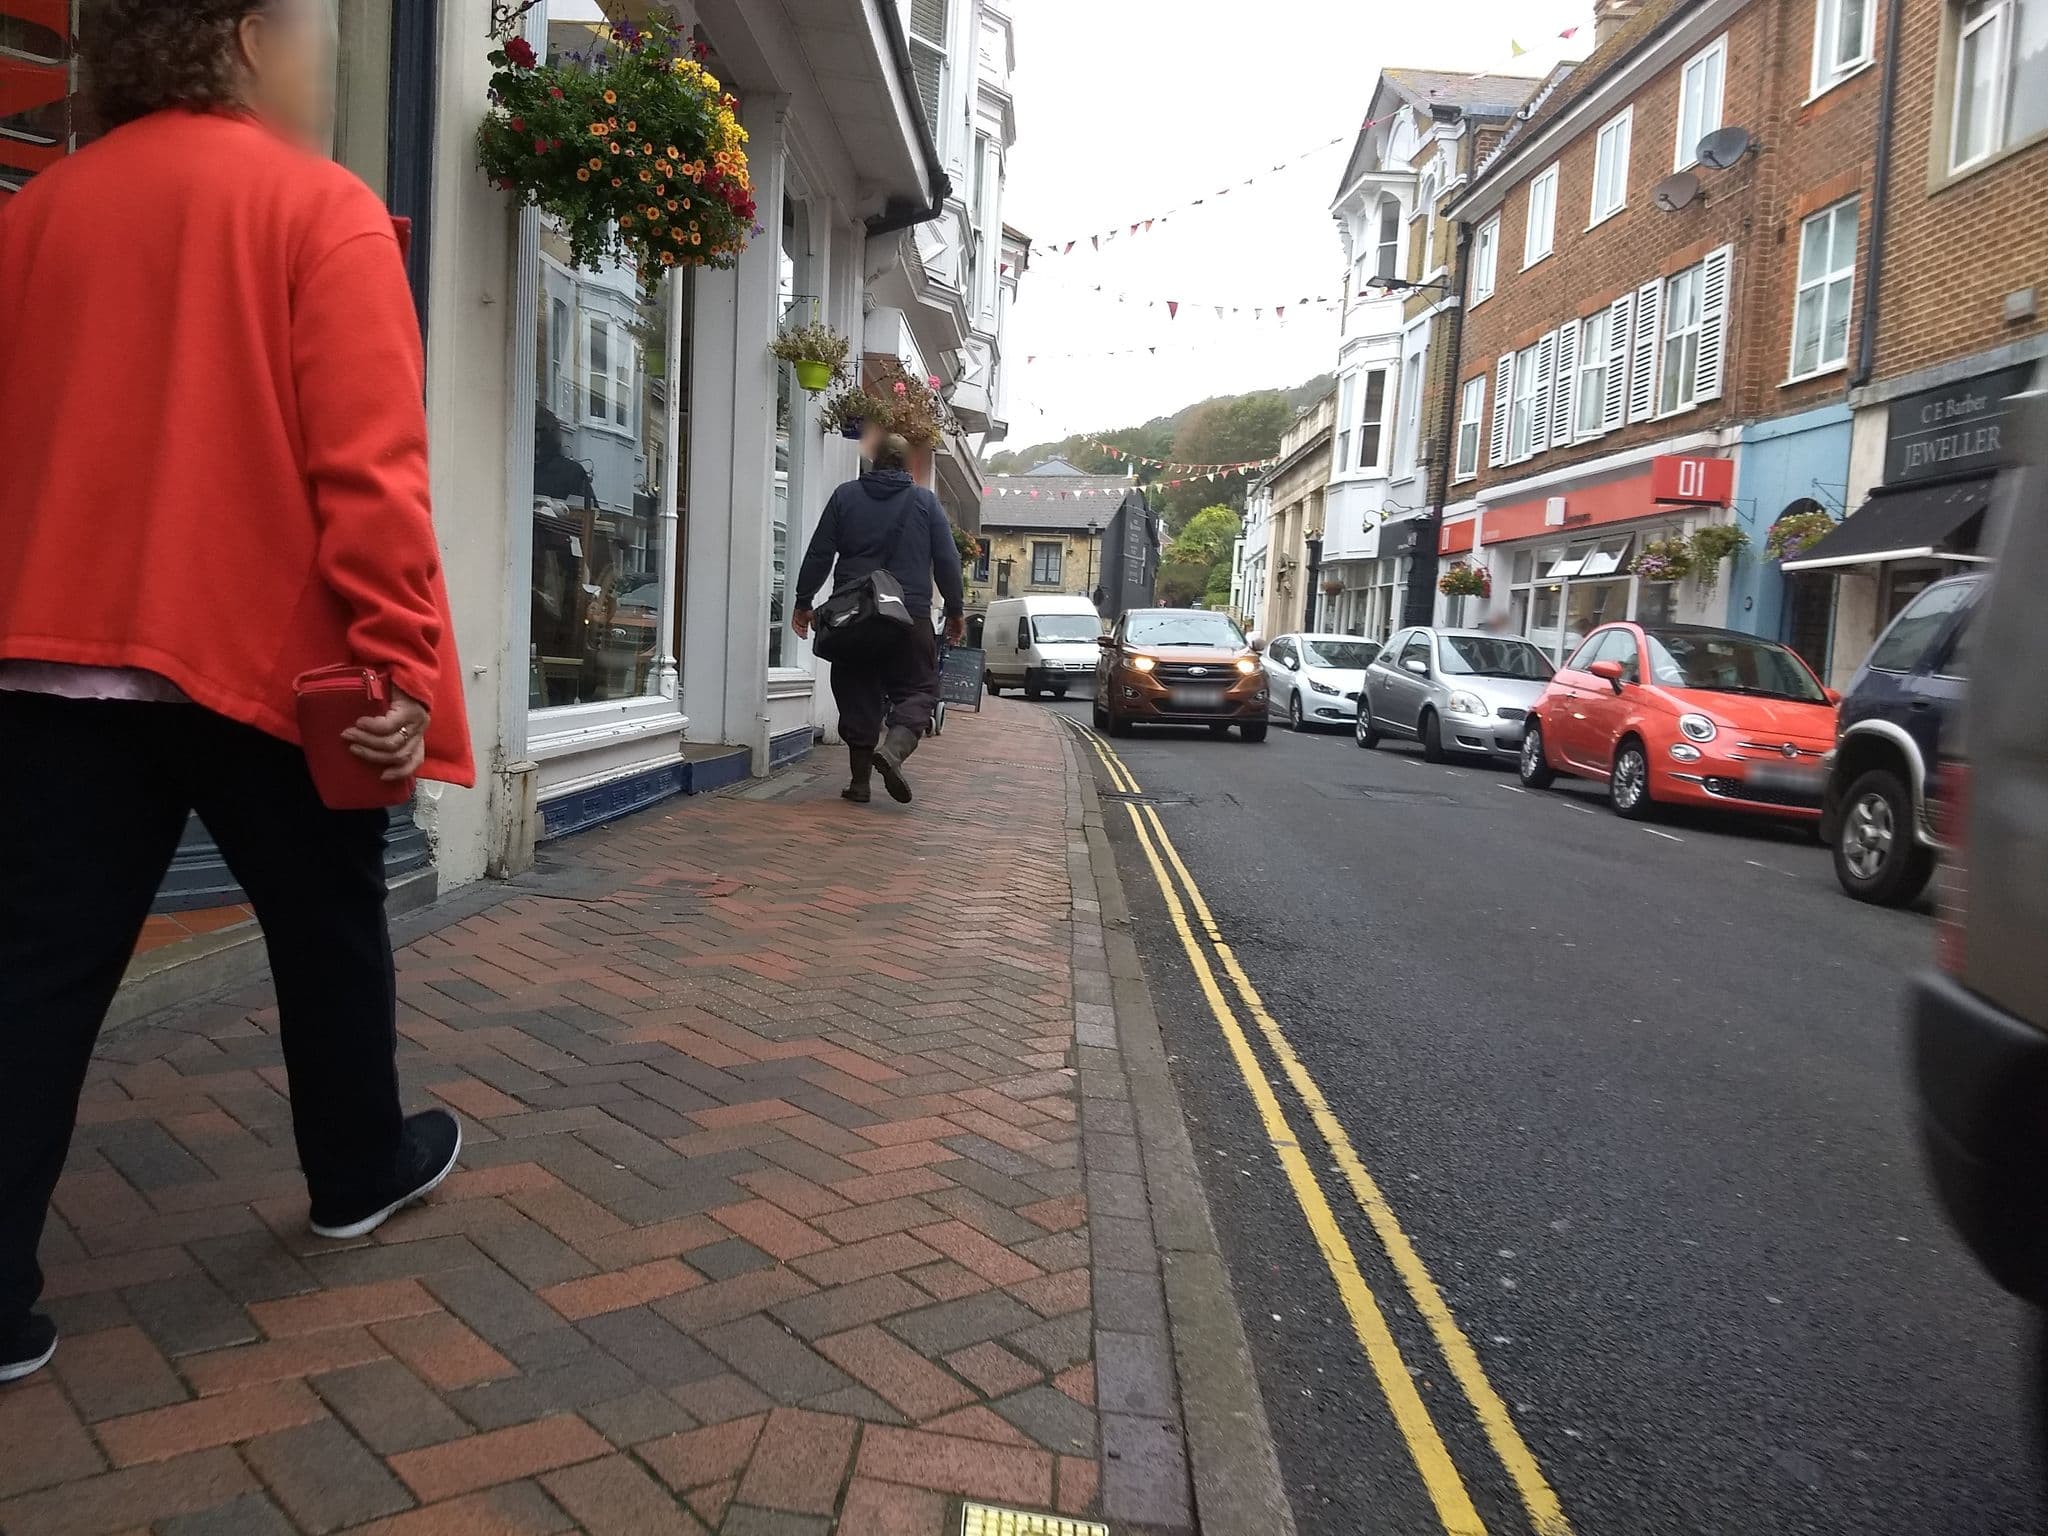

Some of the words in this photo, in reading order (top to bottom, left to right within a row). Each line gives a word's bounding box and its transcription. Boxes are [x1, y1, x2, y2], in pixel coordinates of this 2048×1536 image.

[1921, 404, 1933, 424] C
[1935, 401, 1945, 421] E
[1901, 425, 2001, 477] JEWELLER
